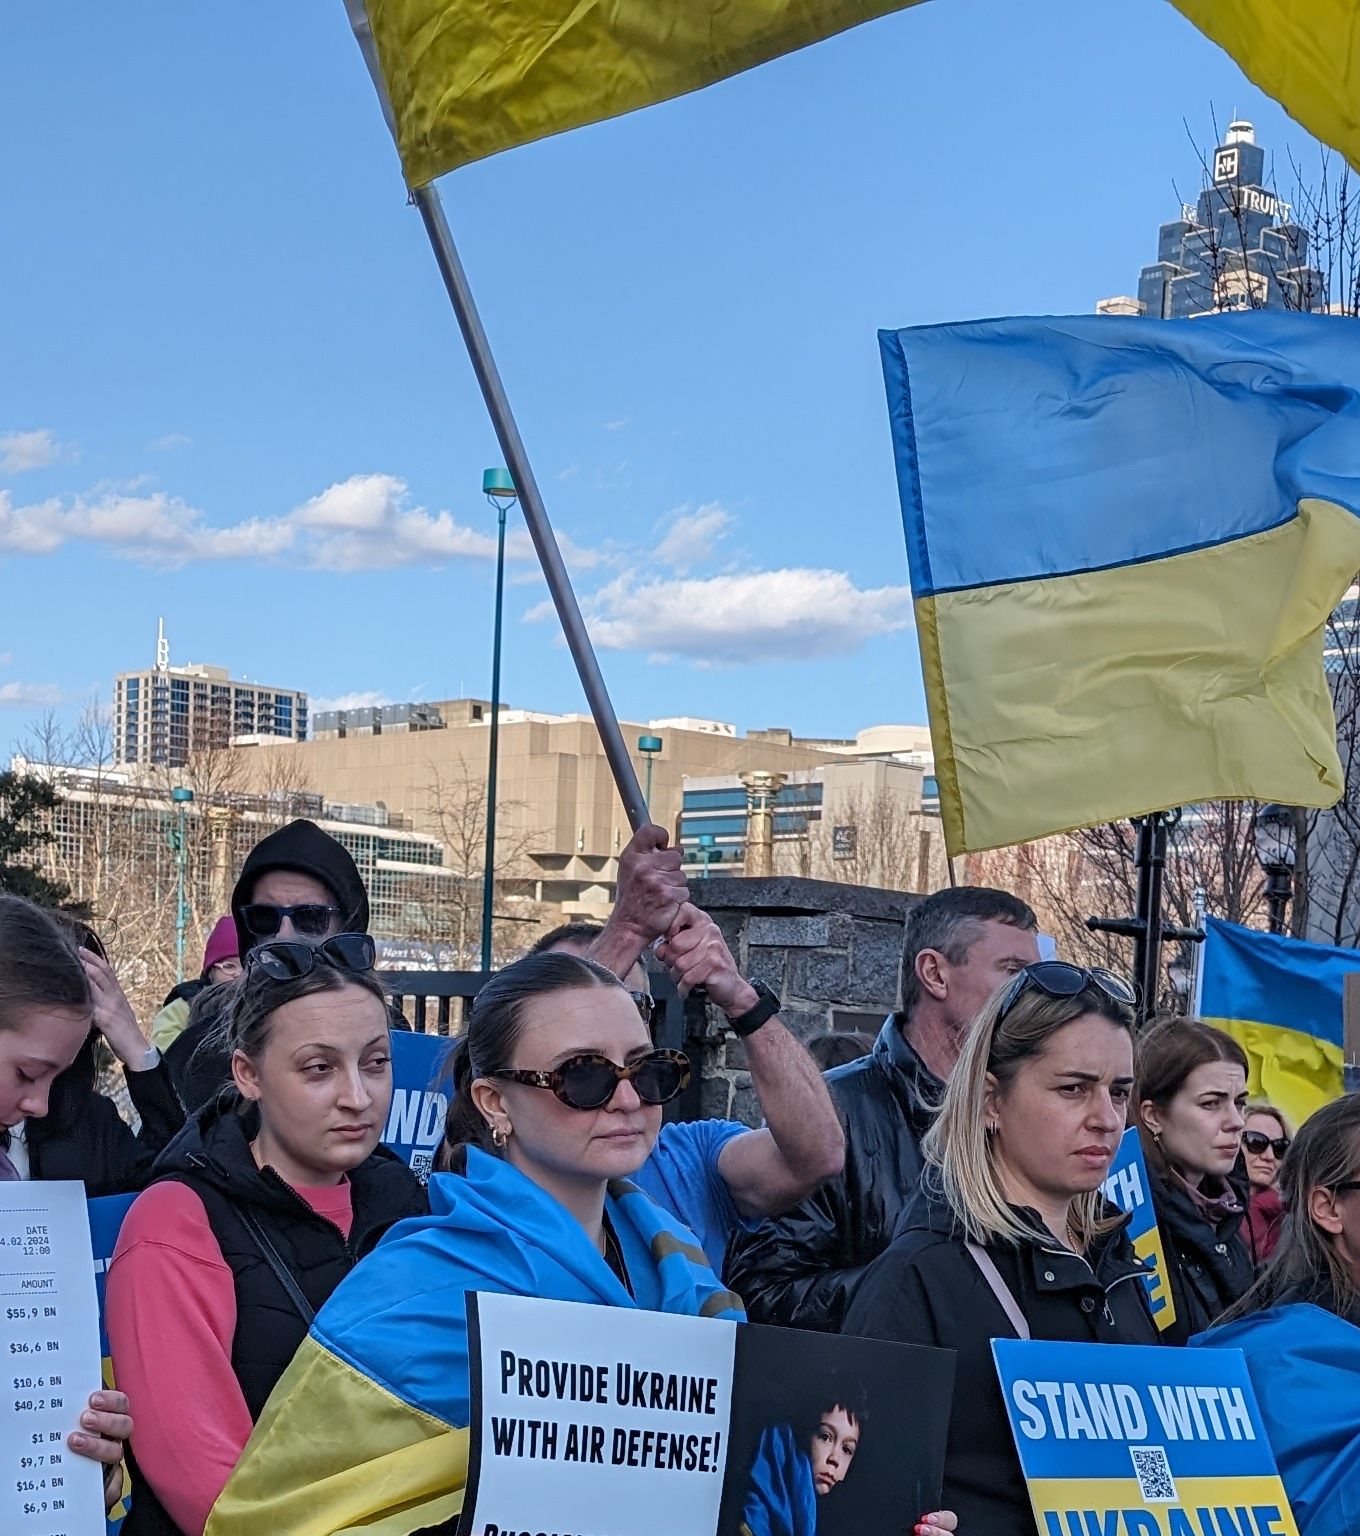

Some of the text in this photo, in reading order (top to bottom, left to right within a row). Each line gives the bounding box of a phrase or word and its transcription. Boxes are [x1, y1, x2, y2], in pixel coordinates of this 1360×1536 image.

[1241, 188, 1291, 222] TRUIST
[26, 1226, 47, 1235] DATE
[23, 1246, 50, 1255] 12:00
[21, 1279, 53, 1290] AMOUNT
[6, 1307, 56, 1320] $55,9 BN
[10, 1341, 59, 1354] $36,6 BN
[13, 1376, 62, 1389] $10,6 BN
[501, 1350, 718, 1414] PROVIDE UKRAINE
[14, 1398, 63, 1412] $40,2 BN
[1012, 1379, 1256, 1441] STAND WITH
[32, 1432, 61, 1444] $1 BN
[492, 1416, 721, 1473] WITH AIR DEFENSE!
[21, 1454, 62, 1467] $9,7 BN
[17, 1477, 64, 1492] $16,4 BN
[24, 1499, 65, 1514] $6,9 BN
